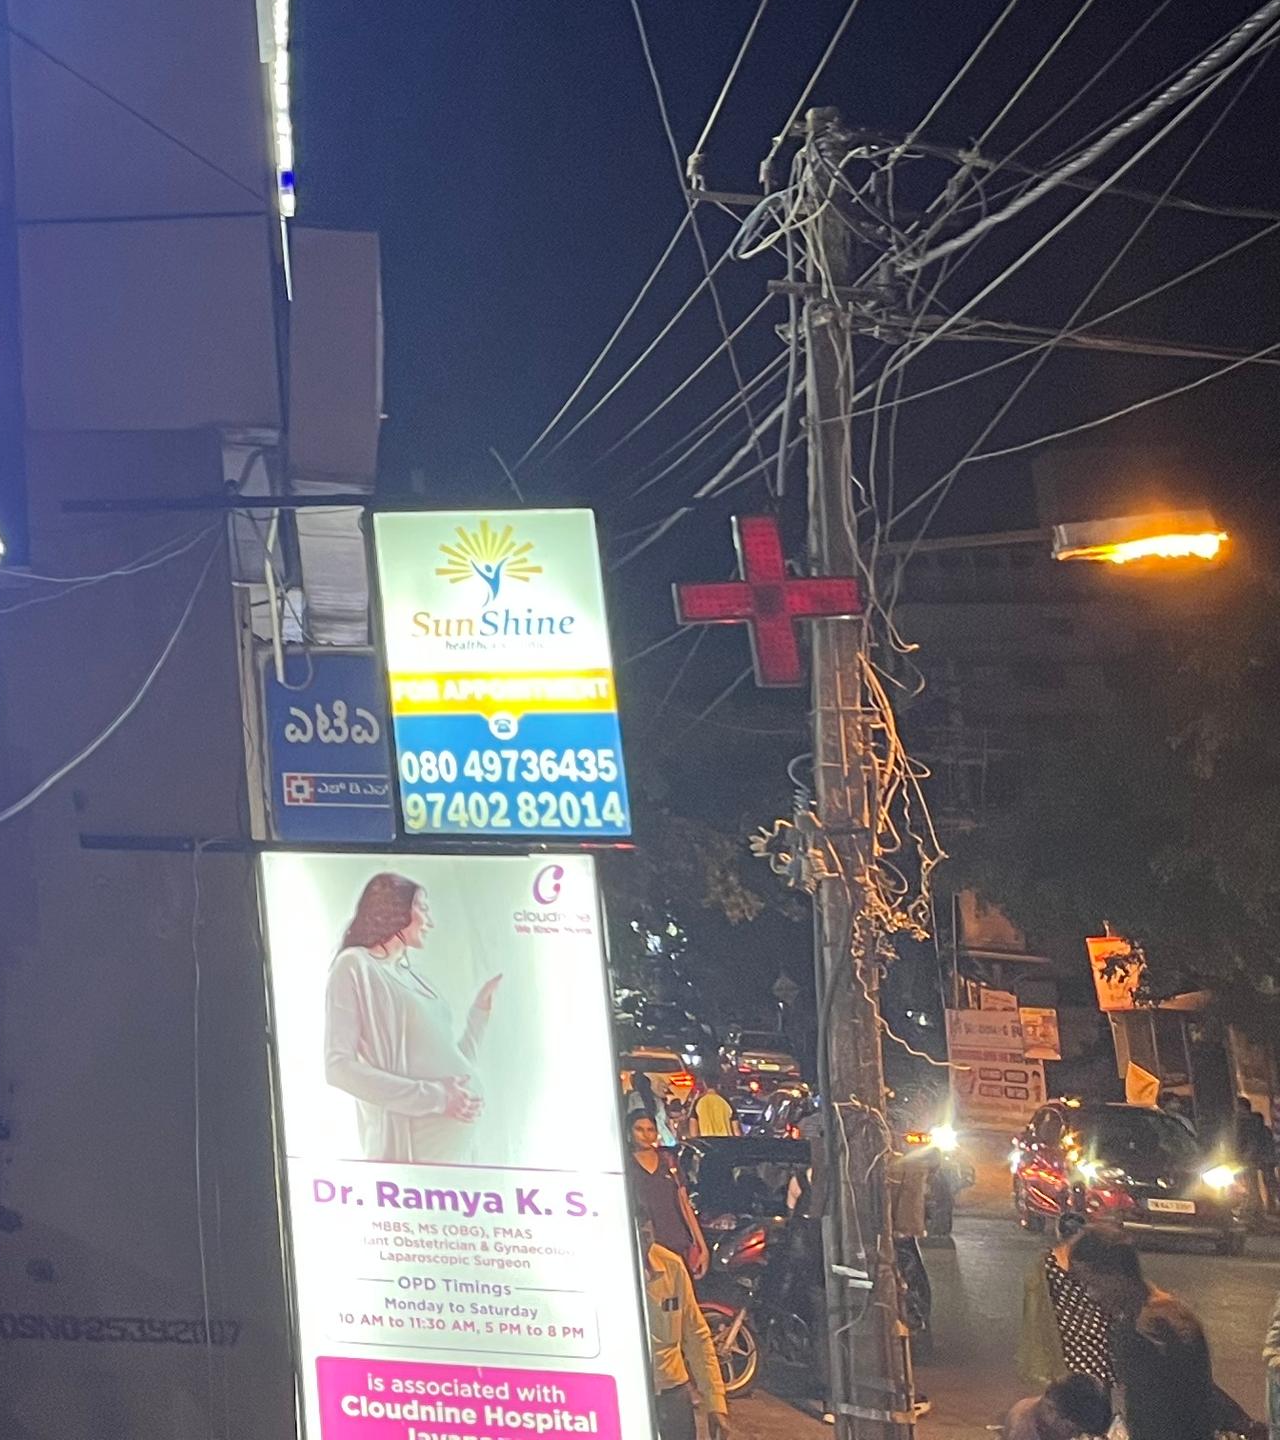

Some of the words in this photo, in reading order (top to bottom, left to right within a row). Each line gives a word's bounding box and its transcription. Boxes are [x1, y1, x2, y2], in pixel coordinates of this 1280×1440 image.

[411, 608, 576, 637] SunShine
[284, 699, 380, 745] ಎಟಿಎ
[400, 750, 457, 784] 080
[463, 748, 618, 783] 49736435
[405, 792, 511, 830] 97402
[517, 791, 625, 829] 82014
[312, 1178, 364, 1206] Dr.
[375, 1180, 504, 1218] Ramya
[515, 1187, 553, 1217] K.
[565, 1190, 599, 1218] S.
[372, 1221, 415, 1235] MBBS,
[419, 1224, 439, 1235] MS
[493, 1227, 533, 1240] FMAS
[392, 1236, 476, 1252] Obstetrician
[480, 1241, 490, 1252] &
[379, 1250, 469, 1268] Laparoscopic
[473, 1255, 531, 1270] Surgeon
[397, 1276, 436, 1291] OPD
[441, 1278, 512, 1296] Timings
[384, 1297, 444, 1314] Monday
[449, 1301, 464, 1314] to
[470, 1302, 538, 1320] Saturday
[339, 1313, 354, 1324] 10
[360, 1314, 383, 1327] AM
[389, 1316, 404, 1328] to
[410, 1317, 446, 1331] 11:30
[451, 1320, 480, 1334] AM,
[485, 1322, 494, 1333] 5
[499, 1323, 522, 1336] PM
[527, 1325, 543, 1337] to
[548, 1326, 556, 1338] 8
[563, 1327, 584, 1339] PM
[367, 1372, 385, 1392] is
[391, 1375, 510, 1400] associated
[516, 1385, 566, 1404] with
[341, 1395, 477, 1425] Cloudnine
[484, 1404, 598, 1434] Hospital
